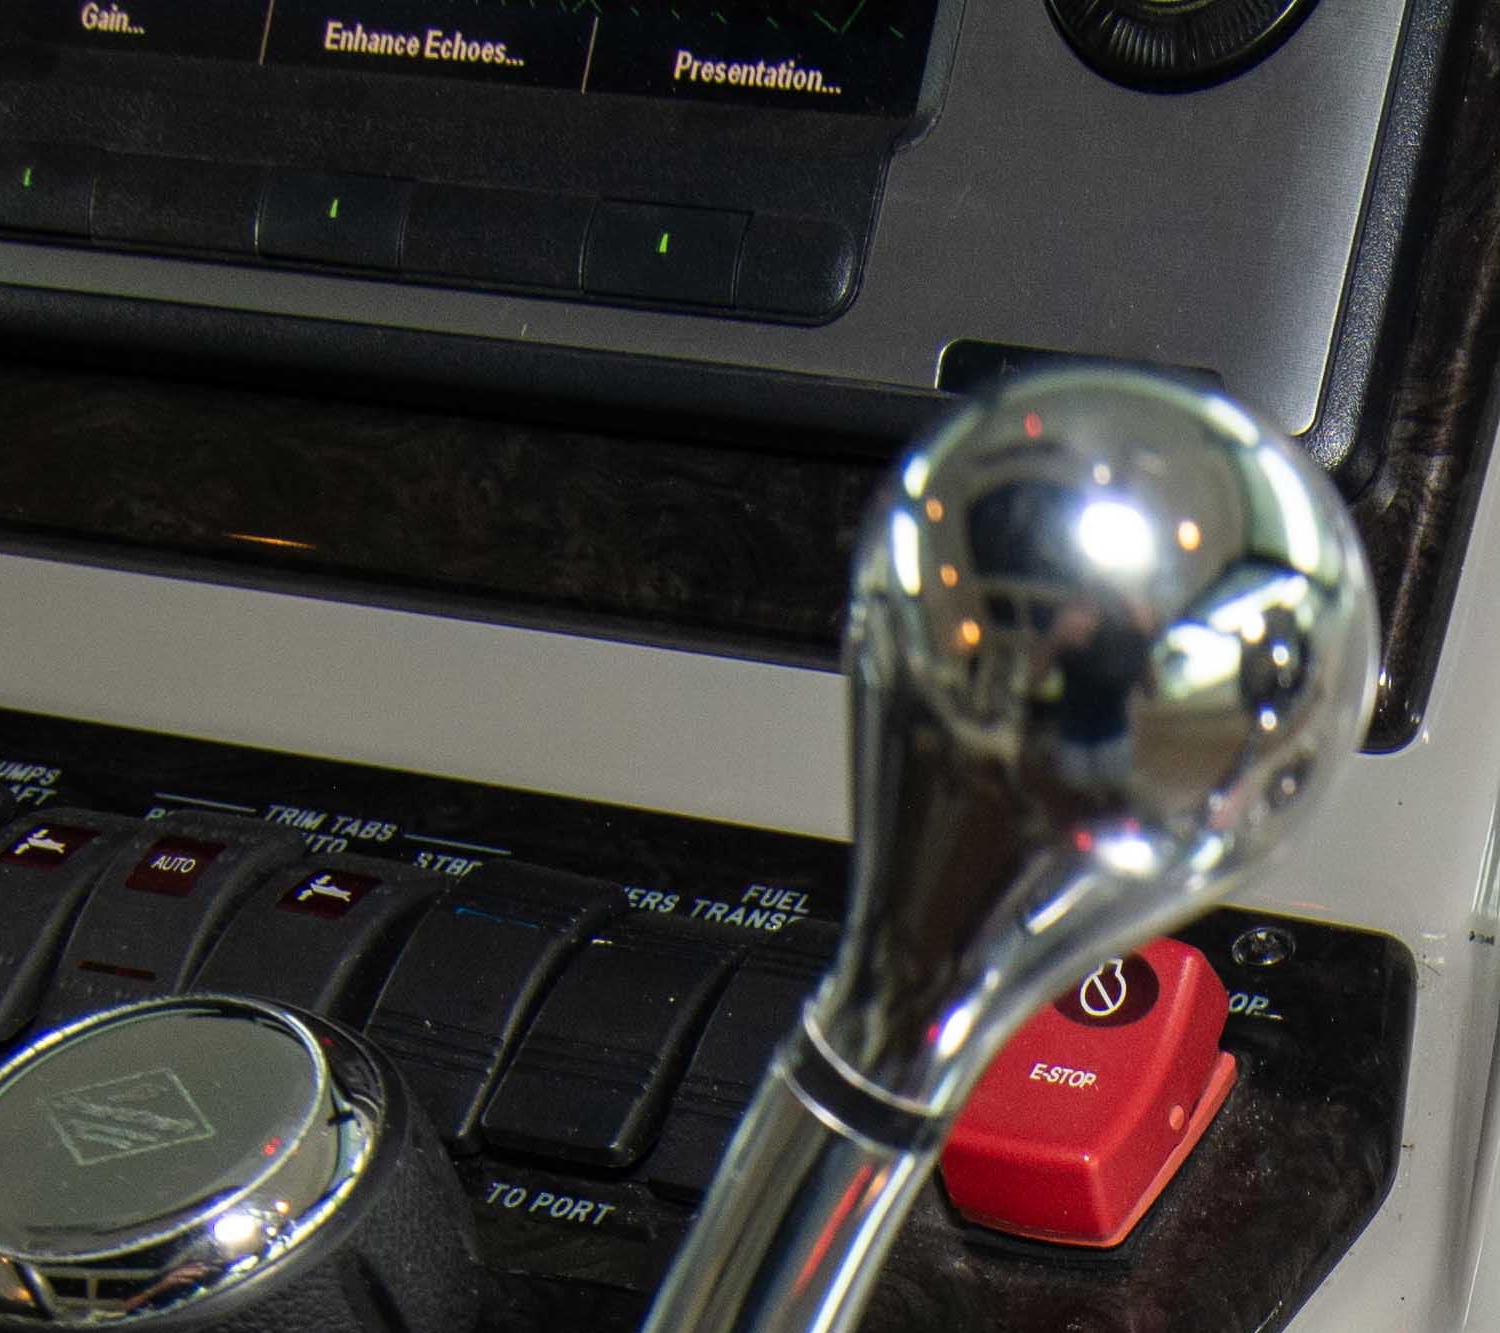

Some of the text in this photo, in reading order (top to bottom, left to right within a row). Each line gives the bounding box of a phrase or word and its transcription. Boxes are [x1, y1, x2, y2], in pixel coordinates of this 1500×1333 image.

[82, 2, 145, 35] Gain...
[325, 20, 525, 66] Enhance Echoes...
[674, 49, 842, 95] Presentation...
[262, 804, 328, 832] TRIM
[330, 813, 399, 842] TABS
[151, 853, 197, 876] AUTO
[741, 884, 811, 915] FUEL
[1029, 1061, 1098, 1090] E-STOP
[486, 1181, 617, 1225] TO PORT
